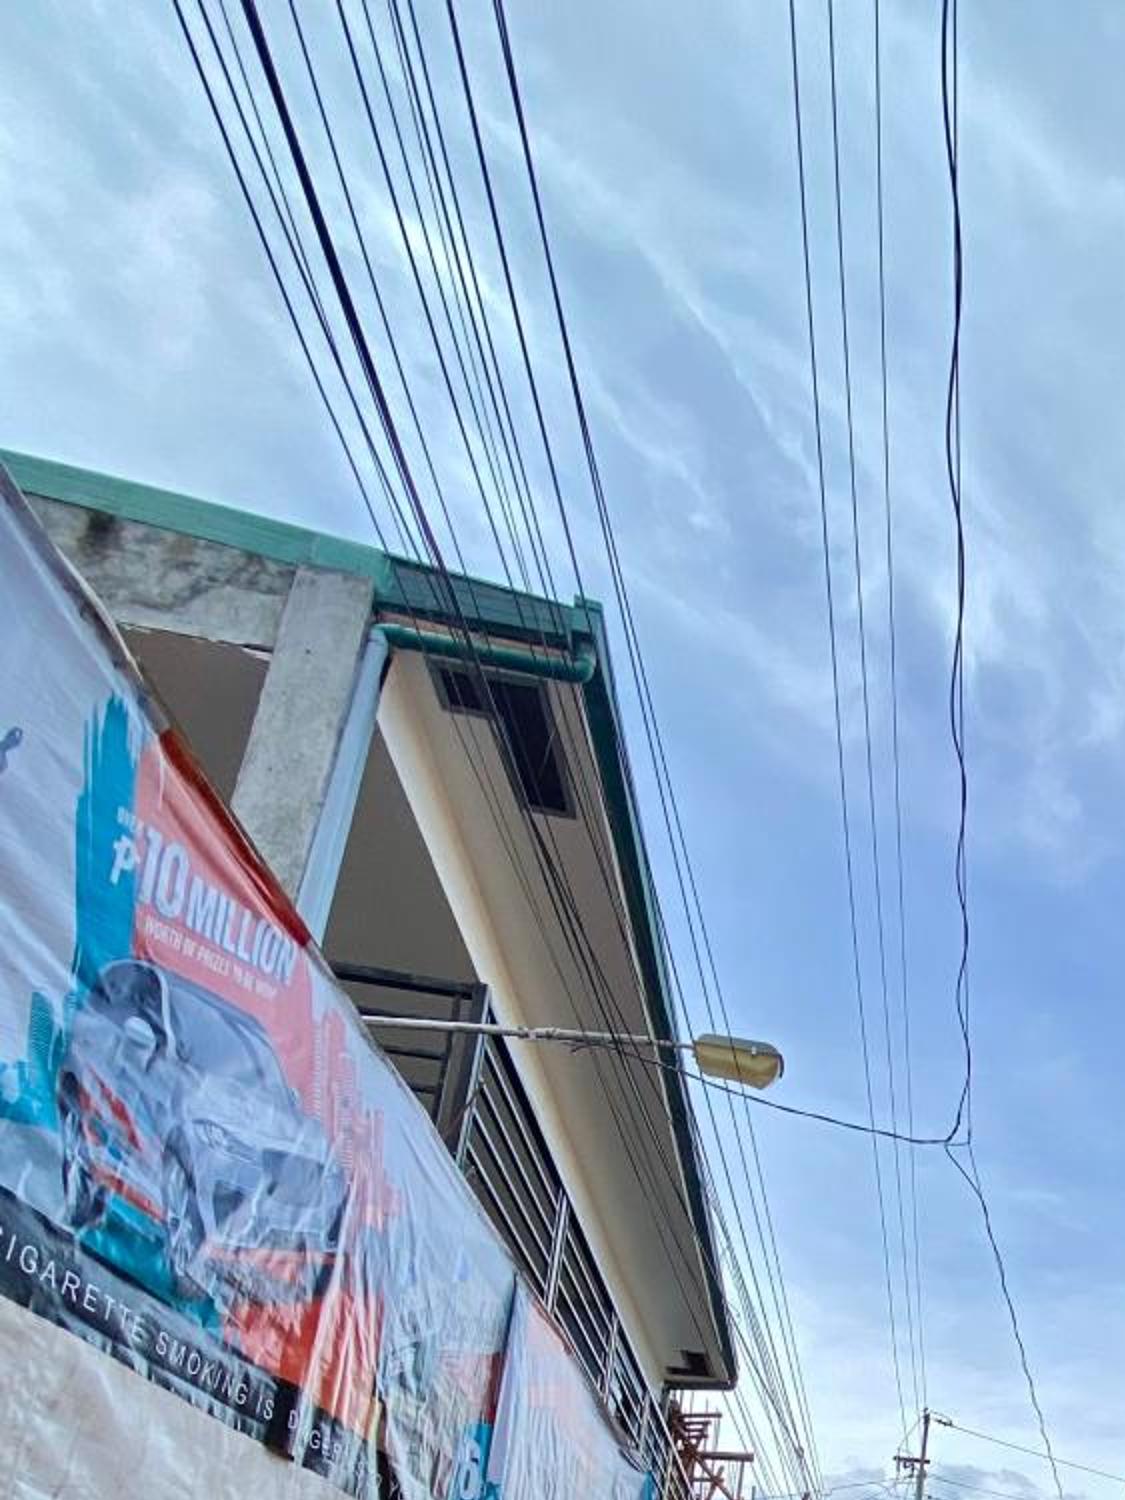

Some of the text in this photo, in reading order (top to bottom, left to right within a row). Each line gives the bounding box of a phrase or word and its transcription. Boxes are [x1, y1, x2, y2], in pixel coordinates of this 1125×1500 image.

[186, 874, 298, 988] MILLION
[0, 1226, 147, 1343] IGARETTE
[155, 1331, 249, 1405] SMOKING
[255, 1394, 275, 1420] IS
